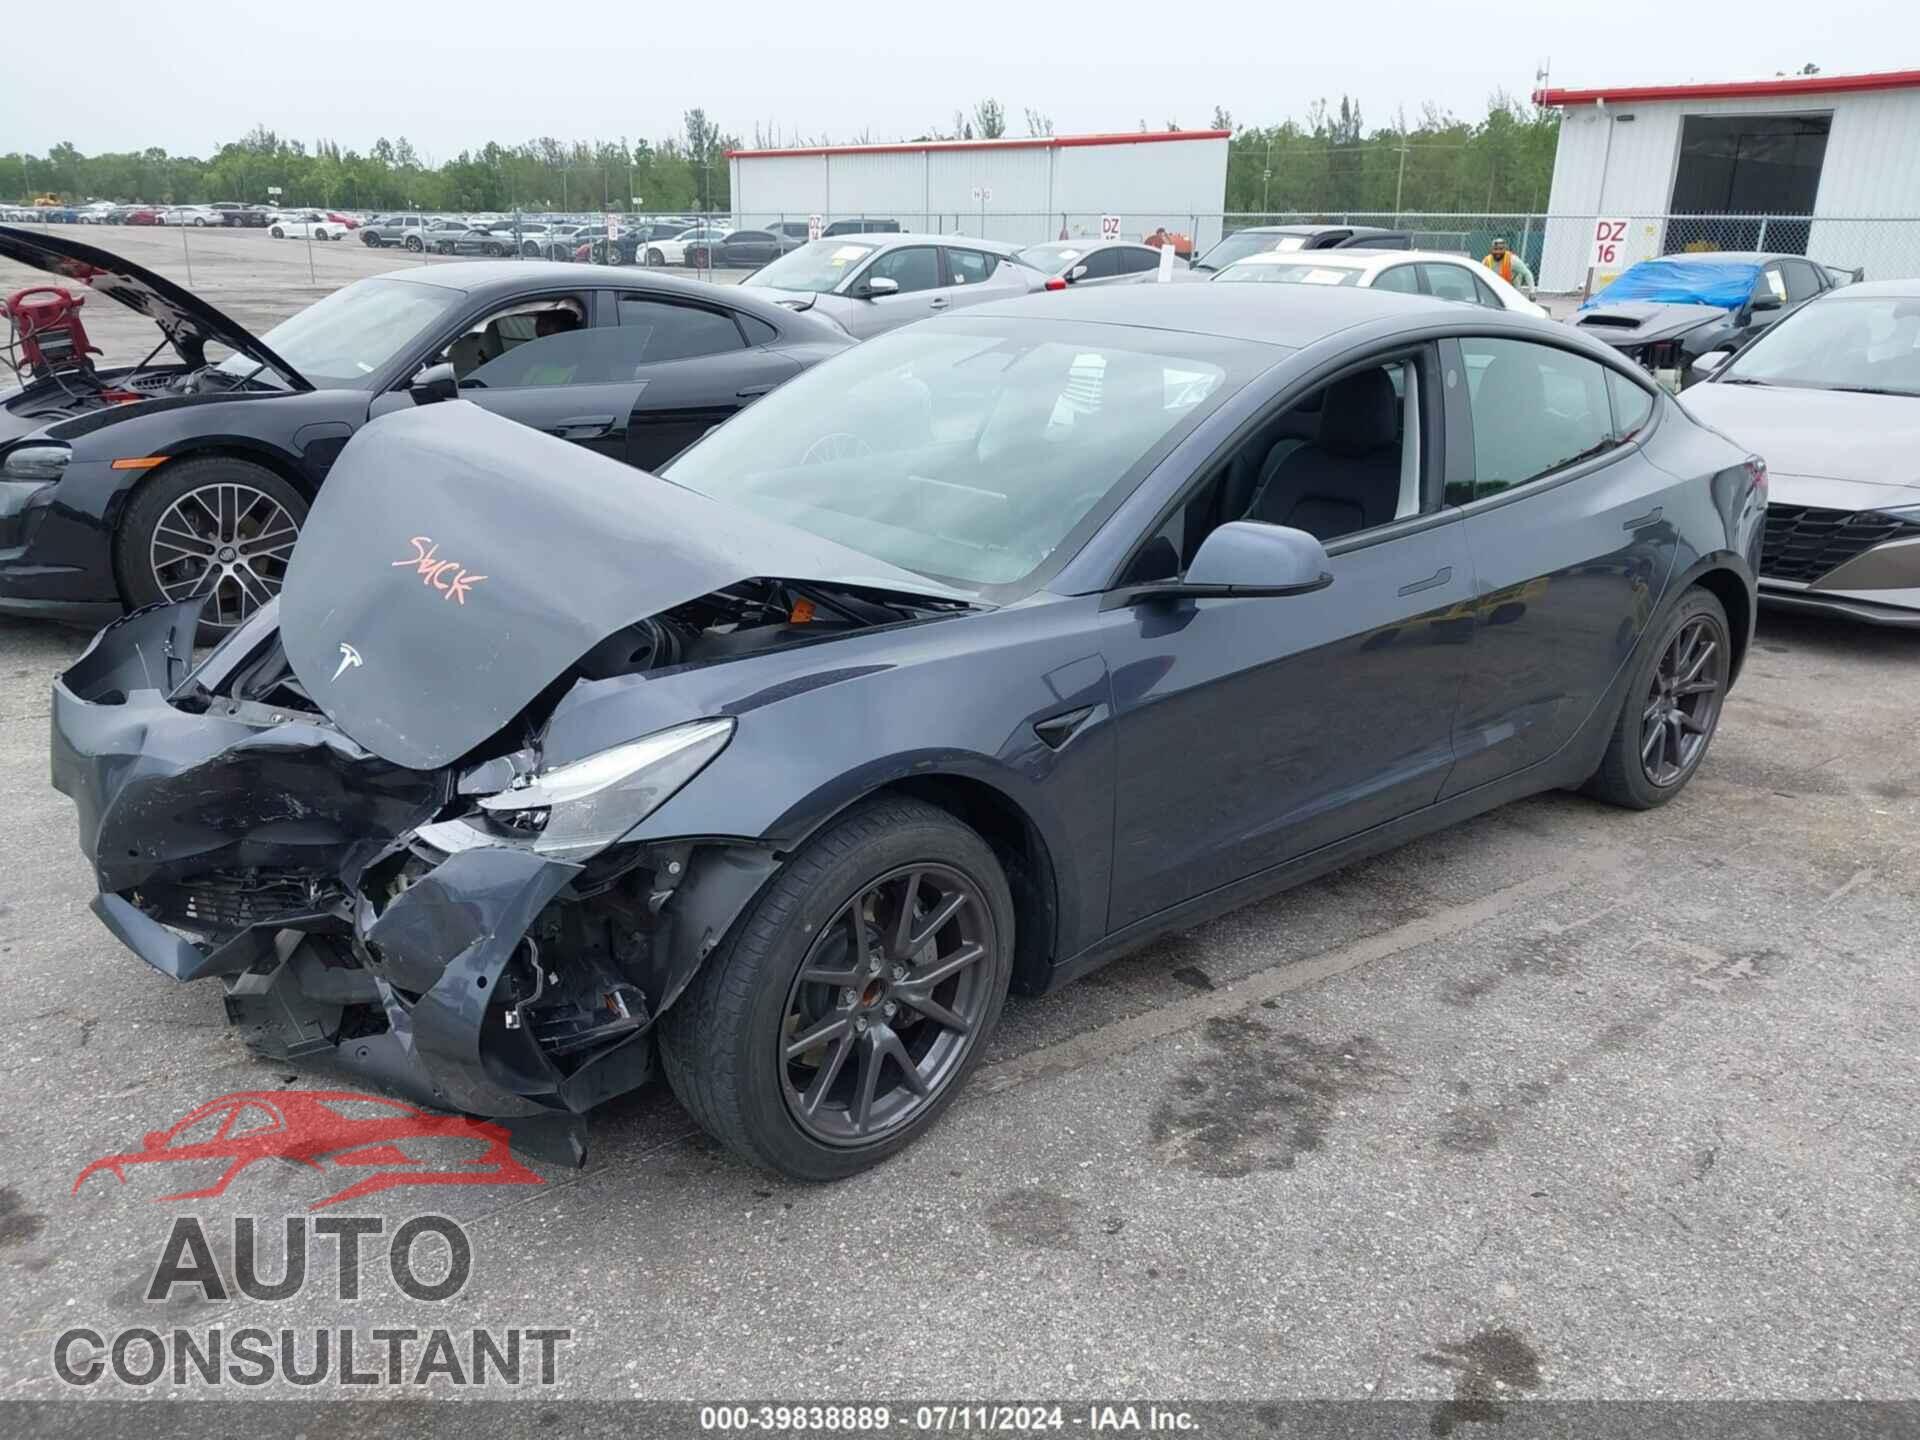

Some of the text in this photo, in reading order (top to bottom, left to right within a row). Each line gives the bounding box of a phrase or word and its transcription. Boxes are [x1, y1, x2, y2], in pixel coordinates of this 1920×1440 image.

[1103, 218, 1119, 234] DZ
[1596, 221, 1627, 241] DZ
[1598, 243, 1616, 263] 16
